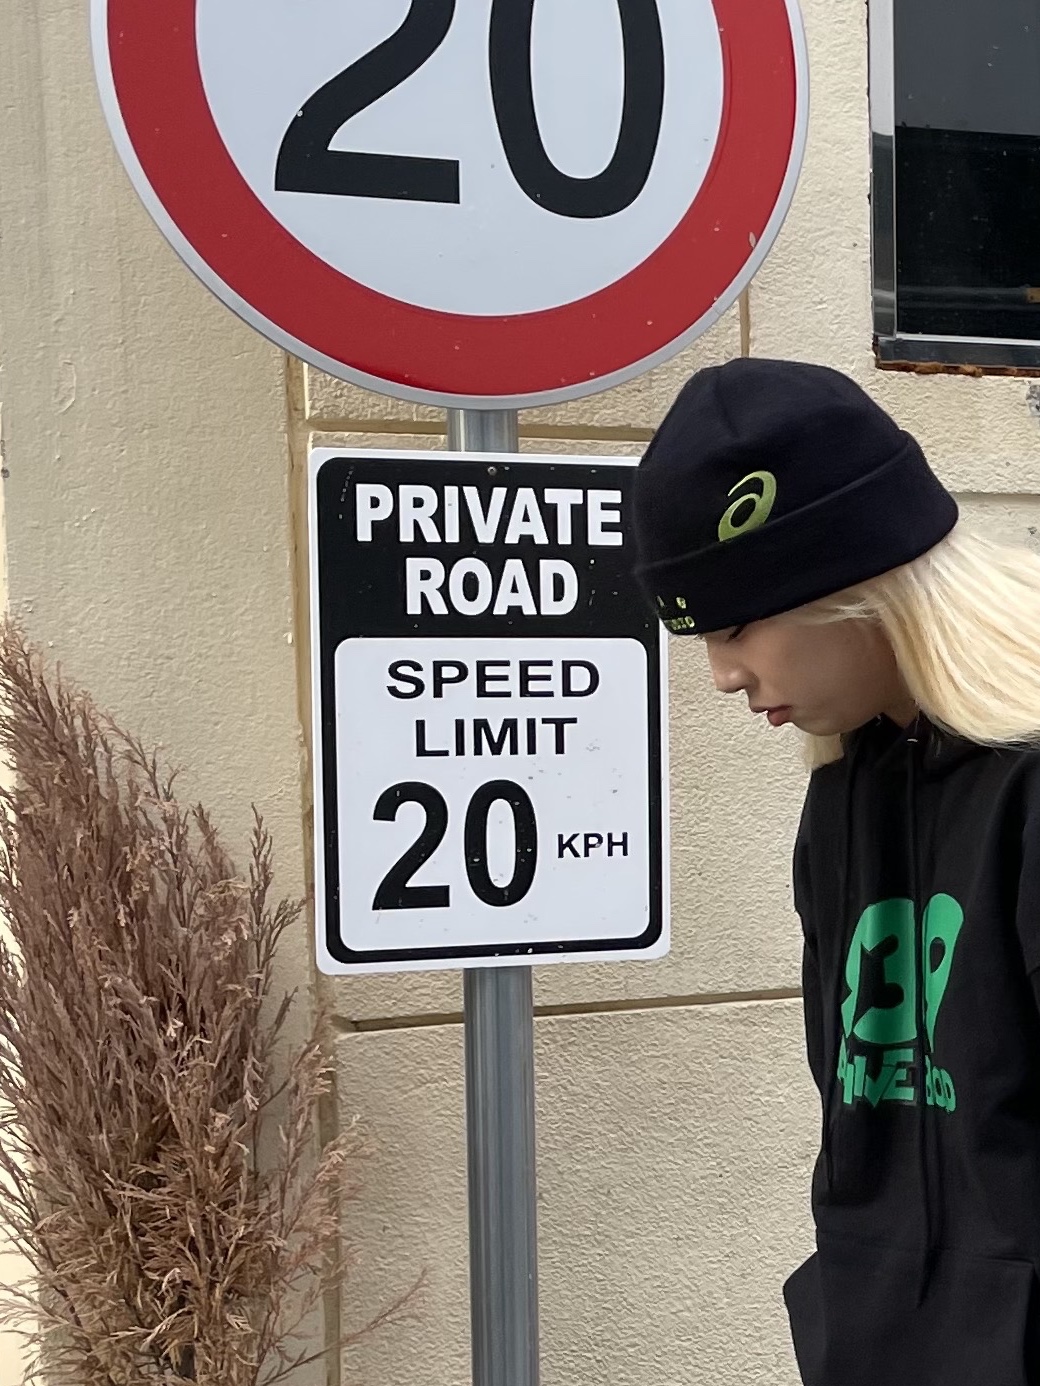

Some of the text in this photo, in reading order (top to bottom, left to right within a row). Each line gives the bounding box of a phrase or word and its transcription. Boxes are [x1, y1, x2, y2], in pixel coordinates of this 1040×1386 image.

[275, 0, 665, 219] 20
[356, 484, 622, 545] PRIVATE
[406, 558, 578, 615] ROAD
[387, 660, 599, 699] SPEED
[416, 718, 577, 757] LIMIT
[372, 780, 628, 910] 20 KPH
